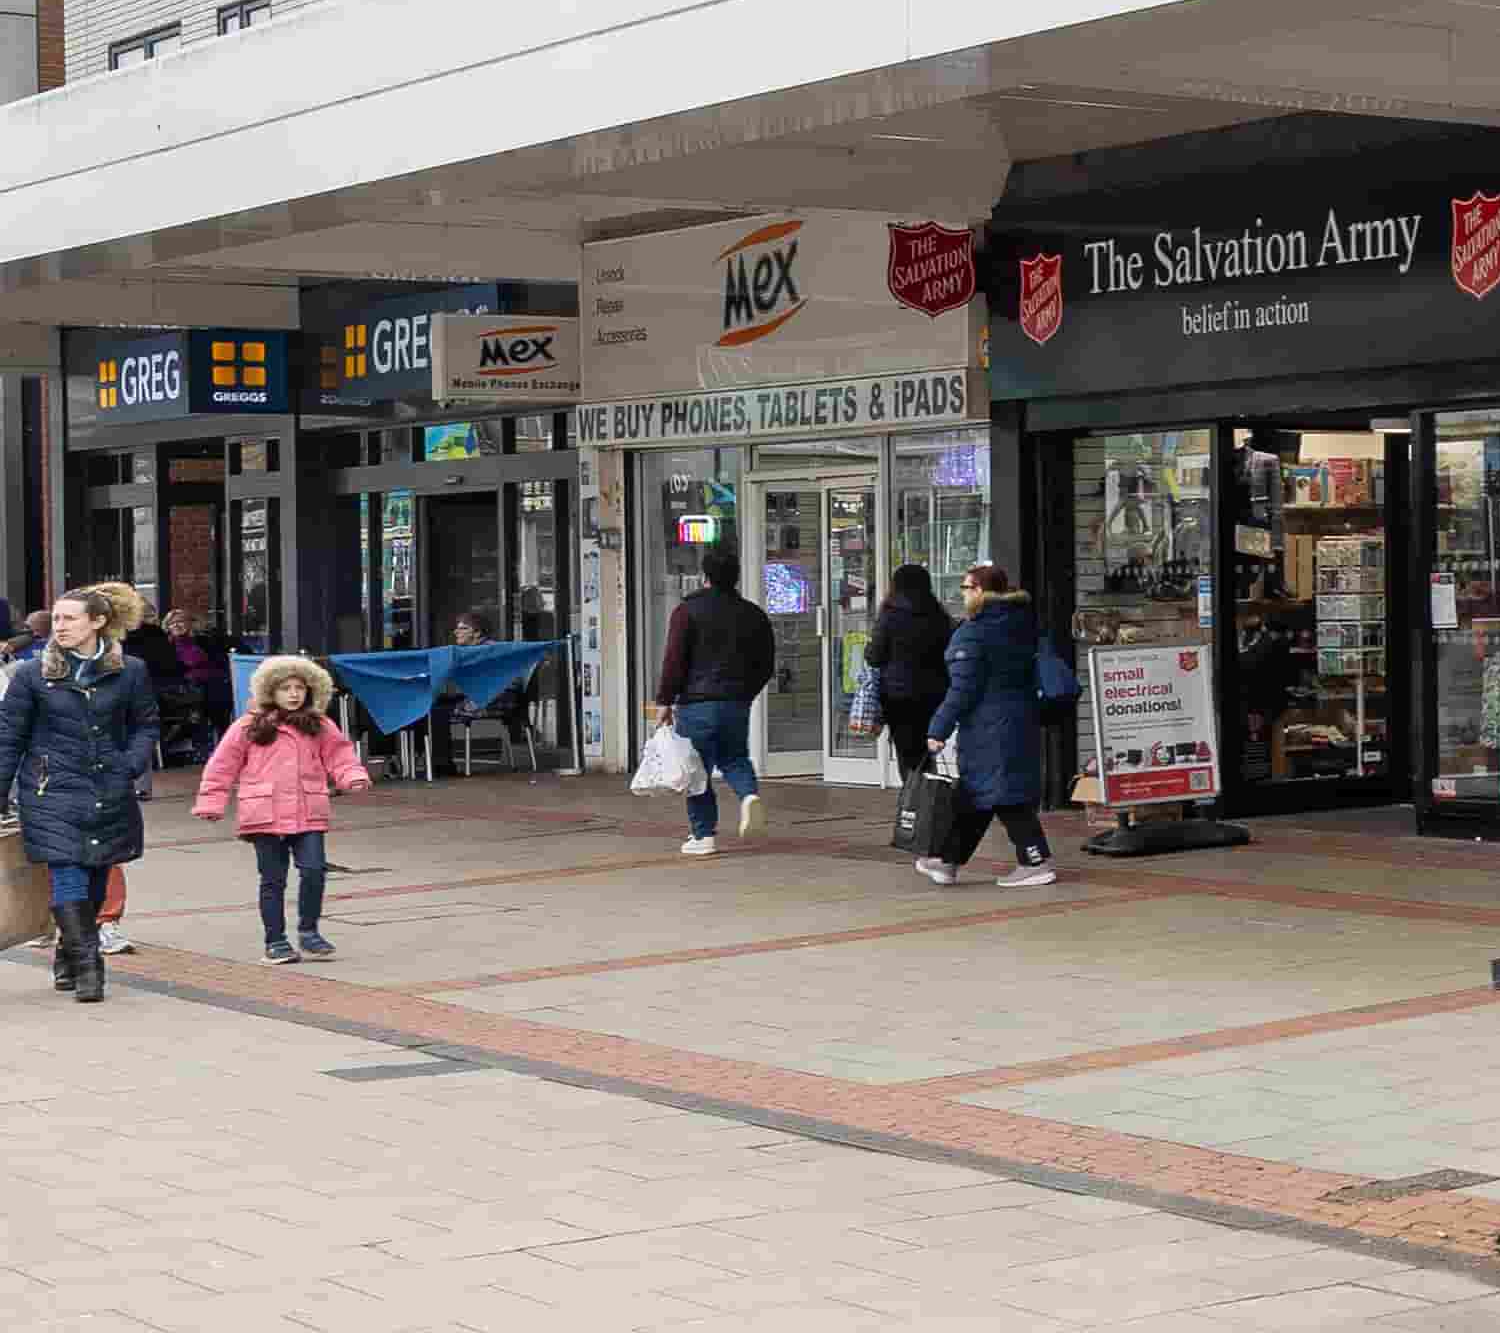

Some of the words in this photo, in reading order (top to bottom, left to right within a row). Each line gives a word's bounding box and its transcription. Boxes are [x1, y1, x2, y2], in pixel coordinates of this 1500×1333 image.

[895, 242, 968, 289] SALVATION
[909, 235, 937, 260] THE
[1085, 241, 1144, 292] The
[1153, 217, 1308, 287] Salvation
[1316, 209, 1421, 273] Army
[922, 269, 965, 303] ARMY
[1182, 299, 1231, 335] belief
[1233, 300, 1251, 330] in
[1256, 297, 1309, 328] action
[373, 314, 433, 373] GRE
[121, 350, 181, 405] GREG
[213, 390, 268, 404] GREGGS
[577, 406, 608, 440] WE
[614, 403, 654, 438] BUY
[662, 395, 751, 437] PHONES,
[757, 386, 856, 430] TABLETS
[869, 382, 885, 420] &
[894, 375, 963, 418] iPADS
[1103, 666, 1145, 682] small
[1104, 682, 1173, 700] electrical
